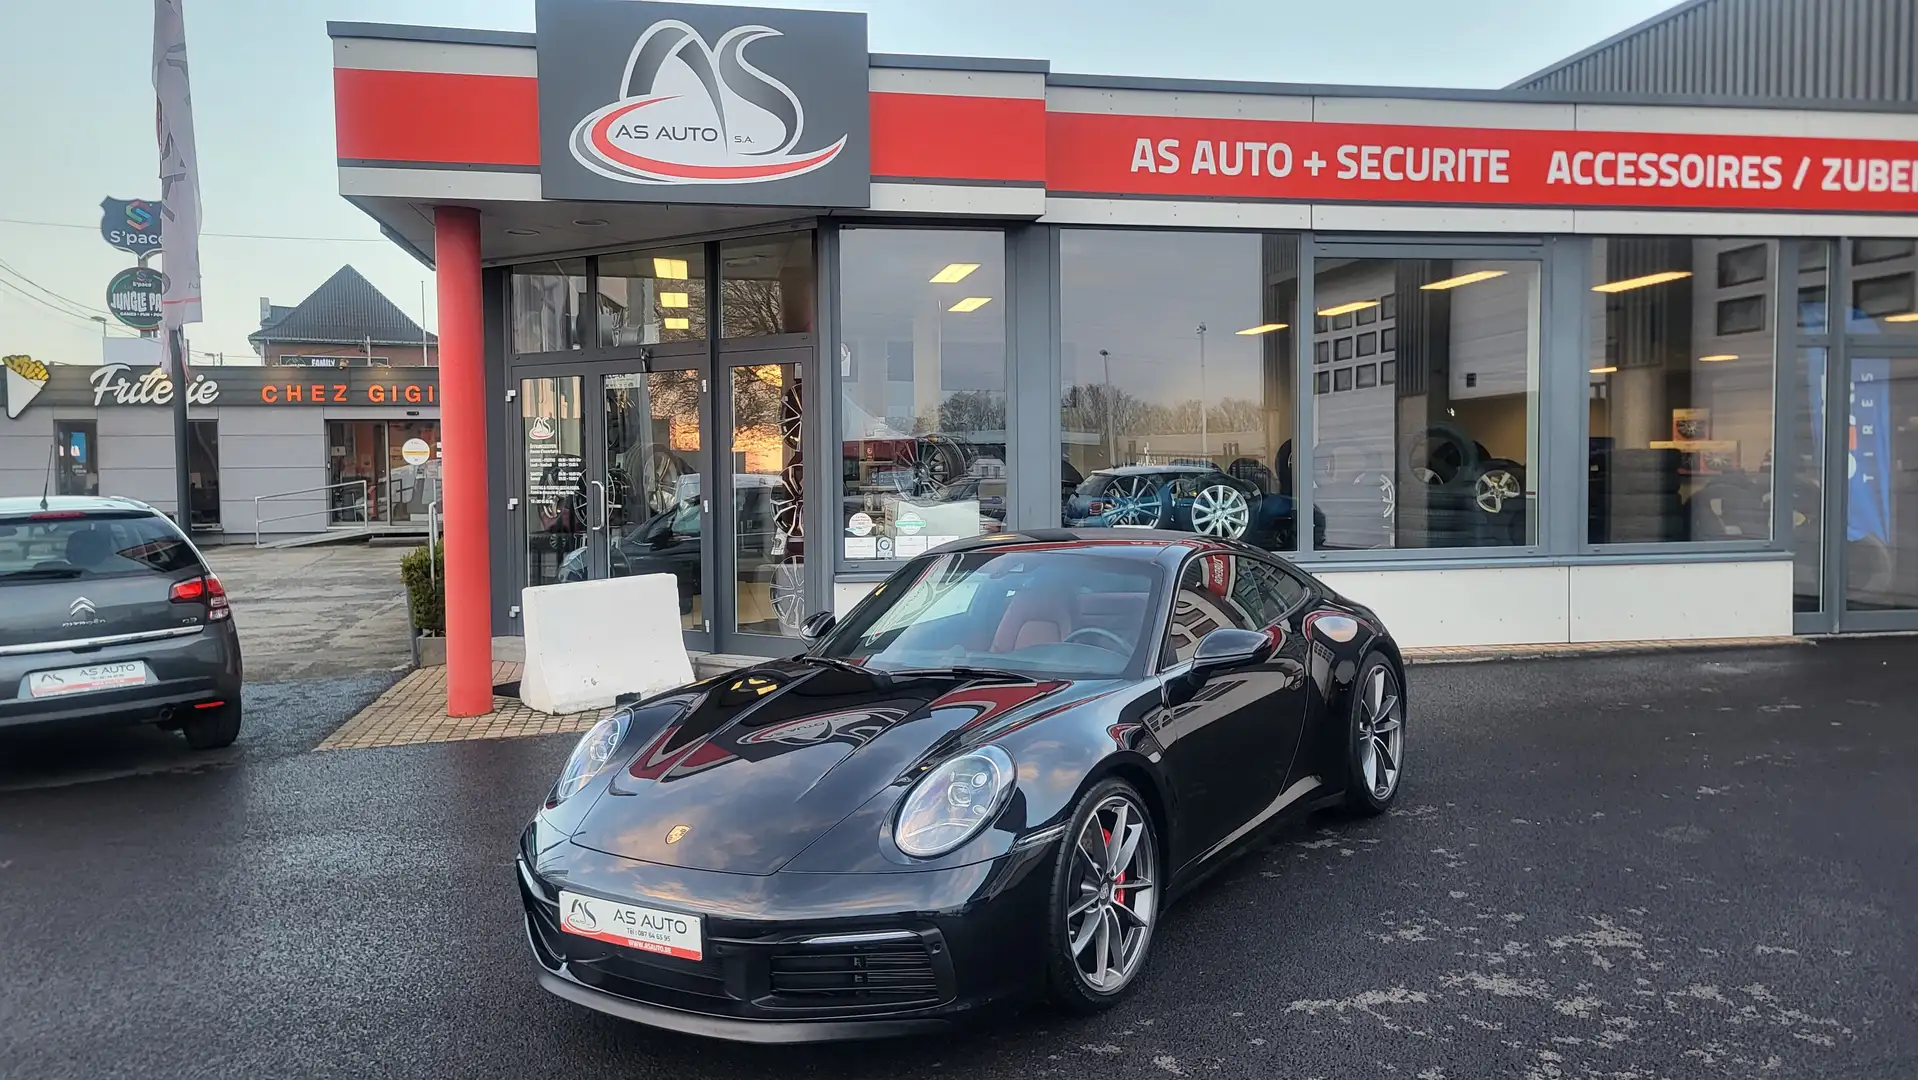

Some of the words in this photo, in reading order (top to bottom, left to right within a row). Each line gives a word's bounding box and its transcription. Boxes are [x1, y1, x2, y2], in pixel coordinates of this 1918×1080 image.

[615, 124, 649, 140] AS
[655, 126, 718, 142] AUTO
[734, 135, 755, 144] S.A.
[1130, 138, 1180, 174] AS
[1191, 140, 1292, 177] AUTO
[1303, 151, 1327, 177] +
[1337, 144, 1510, 184] SECURITE
[1546, 150, 1783, 190] ACCESSOIRES
[1792, 156, 1811, 191] /
[111, 291, 147, 312] JUNGLE
[311, 358, 336, 367] FAMILY
[89, 363, 220, 407] Friteie
[261, 384, 348, 403] CHEZ
[368, 384, 434, 403] GIGI
[1861, 373, 1874, 483] TIRES
[79, 669, 98, 677] AS
[101, 663, 136, 675] AUTO
[613, 908, 637, 926] AS
[640, 914, 688, 935] AUTO
